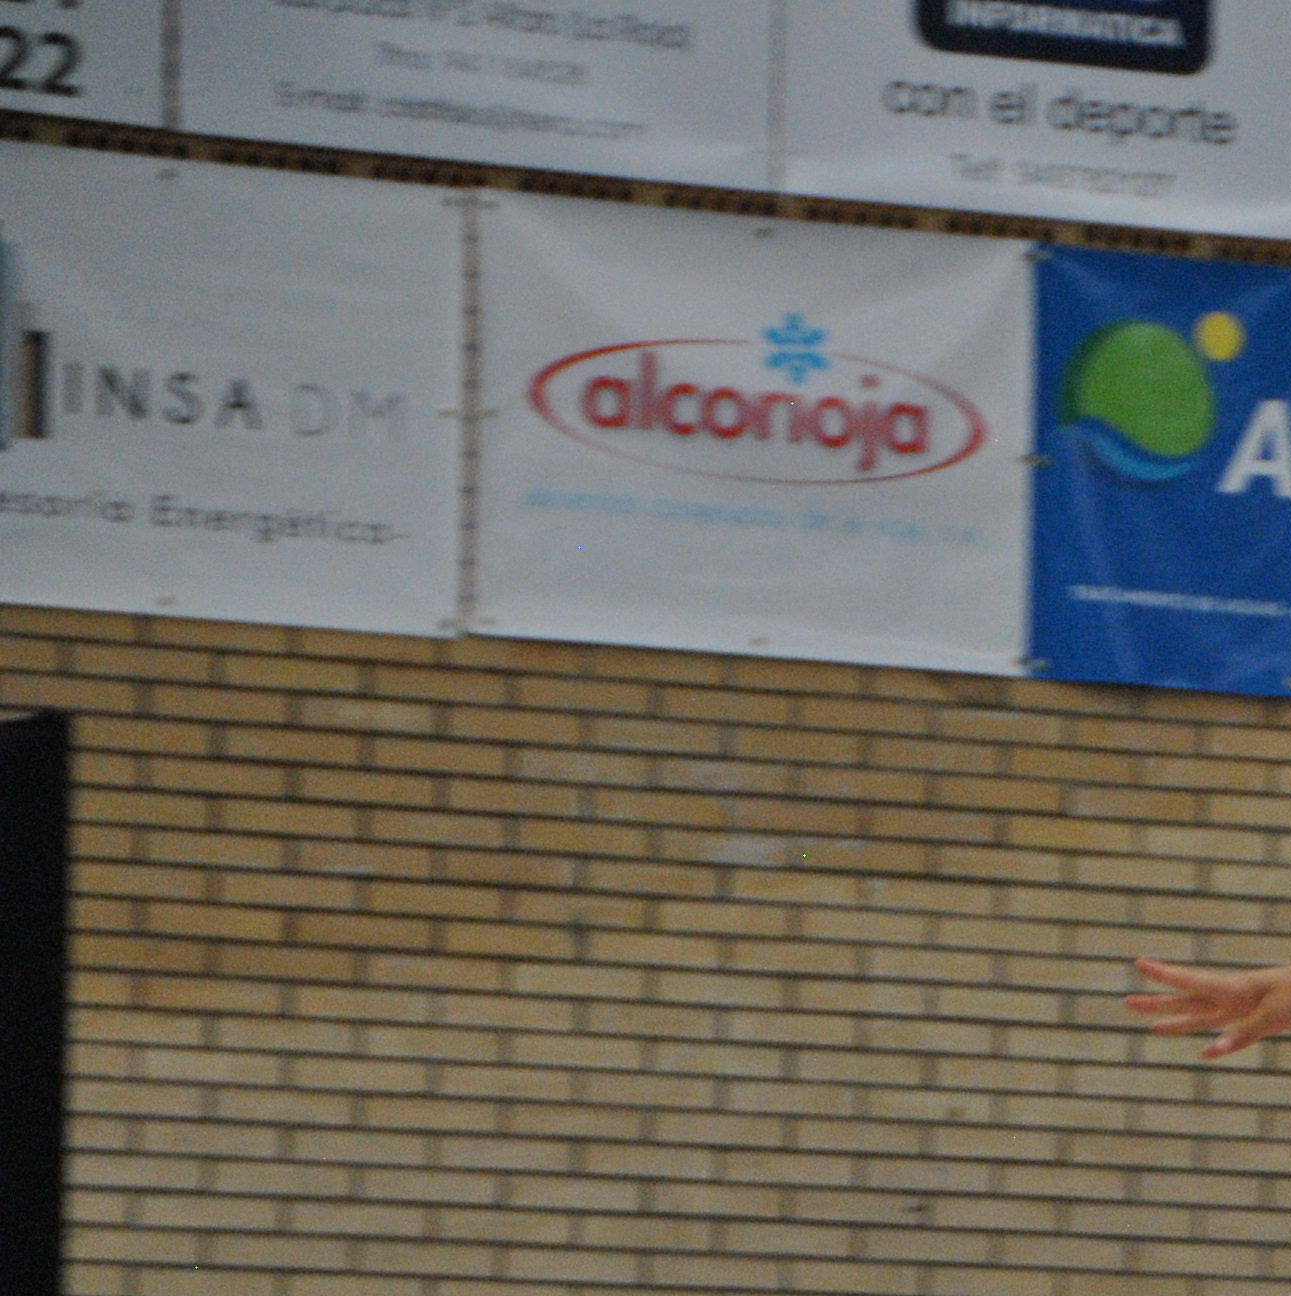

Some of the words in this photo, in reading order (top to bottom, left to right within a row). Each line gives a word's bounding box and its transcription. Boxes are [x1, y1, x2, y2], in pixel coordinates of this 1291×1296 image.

[882, 80, 979, 118] con
[988, 84, 1036, 126] el
[1045, 90, 1238, 146] deporte
